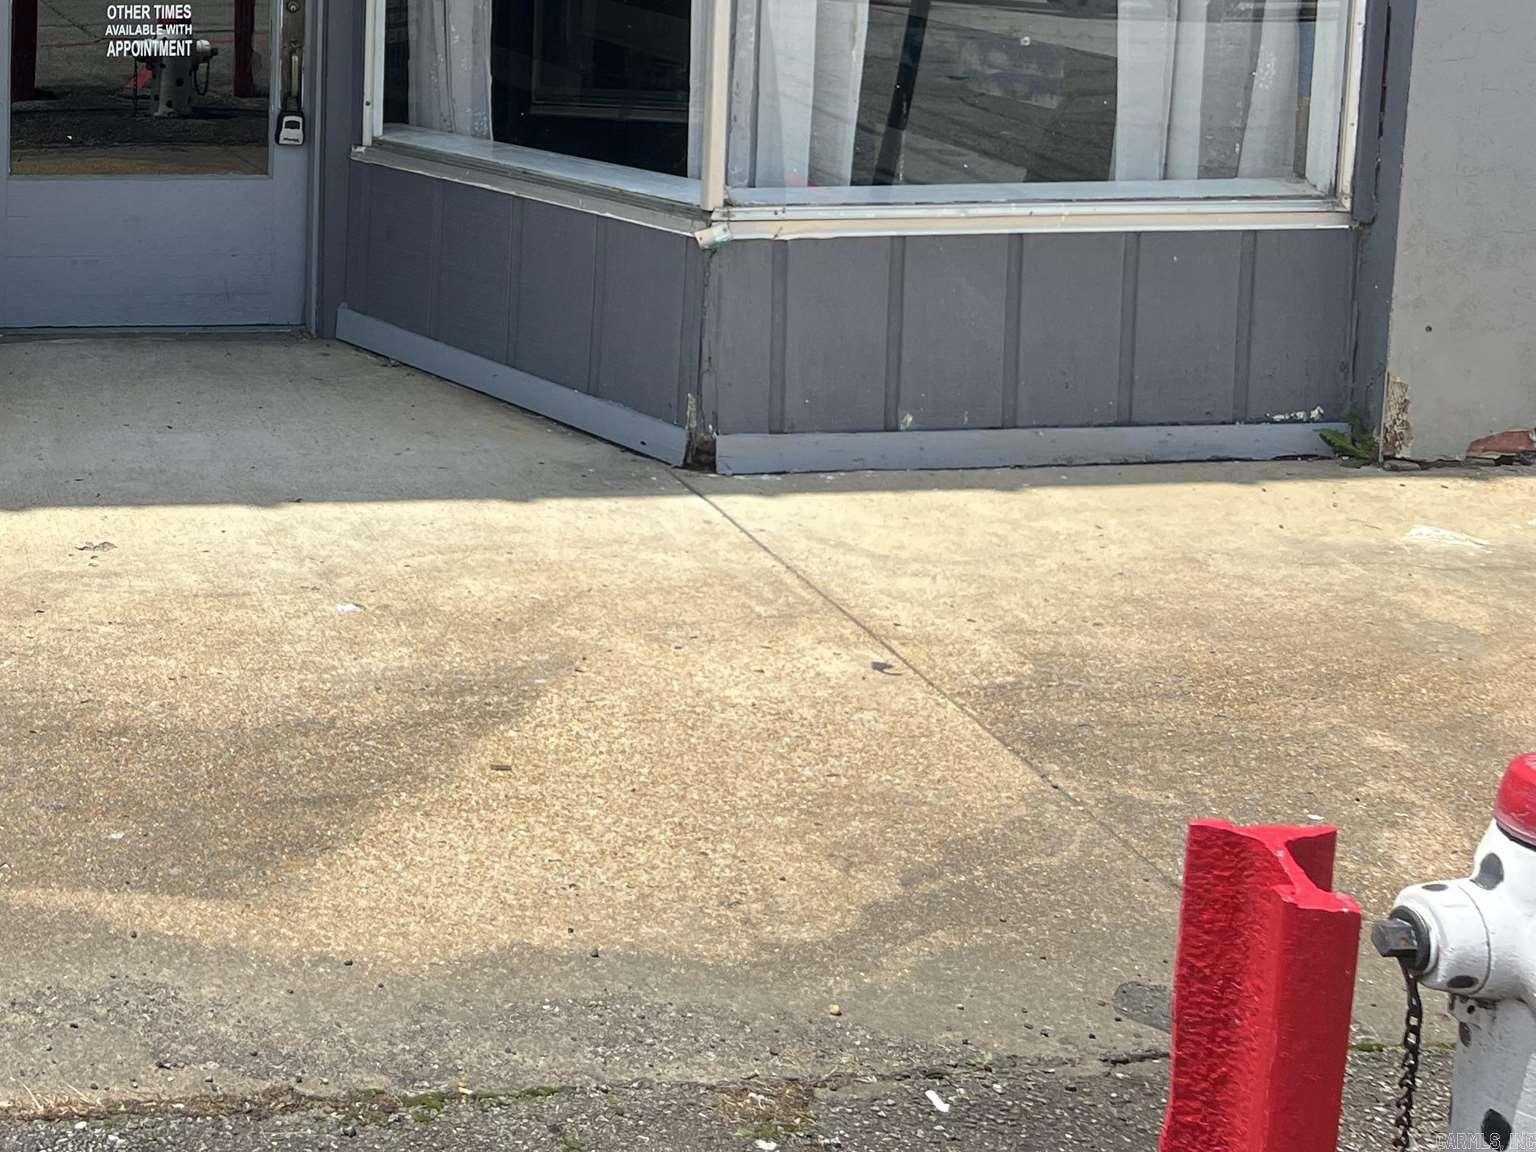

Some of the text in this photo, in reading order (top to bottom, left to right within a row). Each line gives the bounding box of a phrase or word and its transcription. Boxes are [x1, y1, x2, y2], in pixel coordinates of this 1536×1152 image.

[106, 4, 192, 20] OTHER TIMES
[105, 24, 193, 36] AVAILABLE WITH
[106, 39, 193, 57] APPOINTMENT
